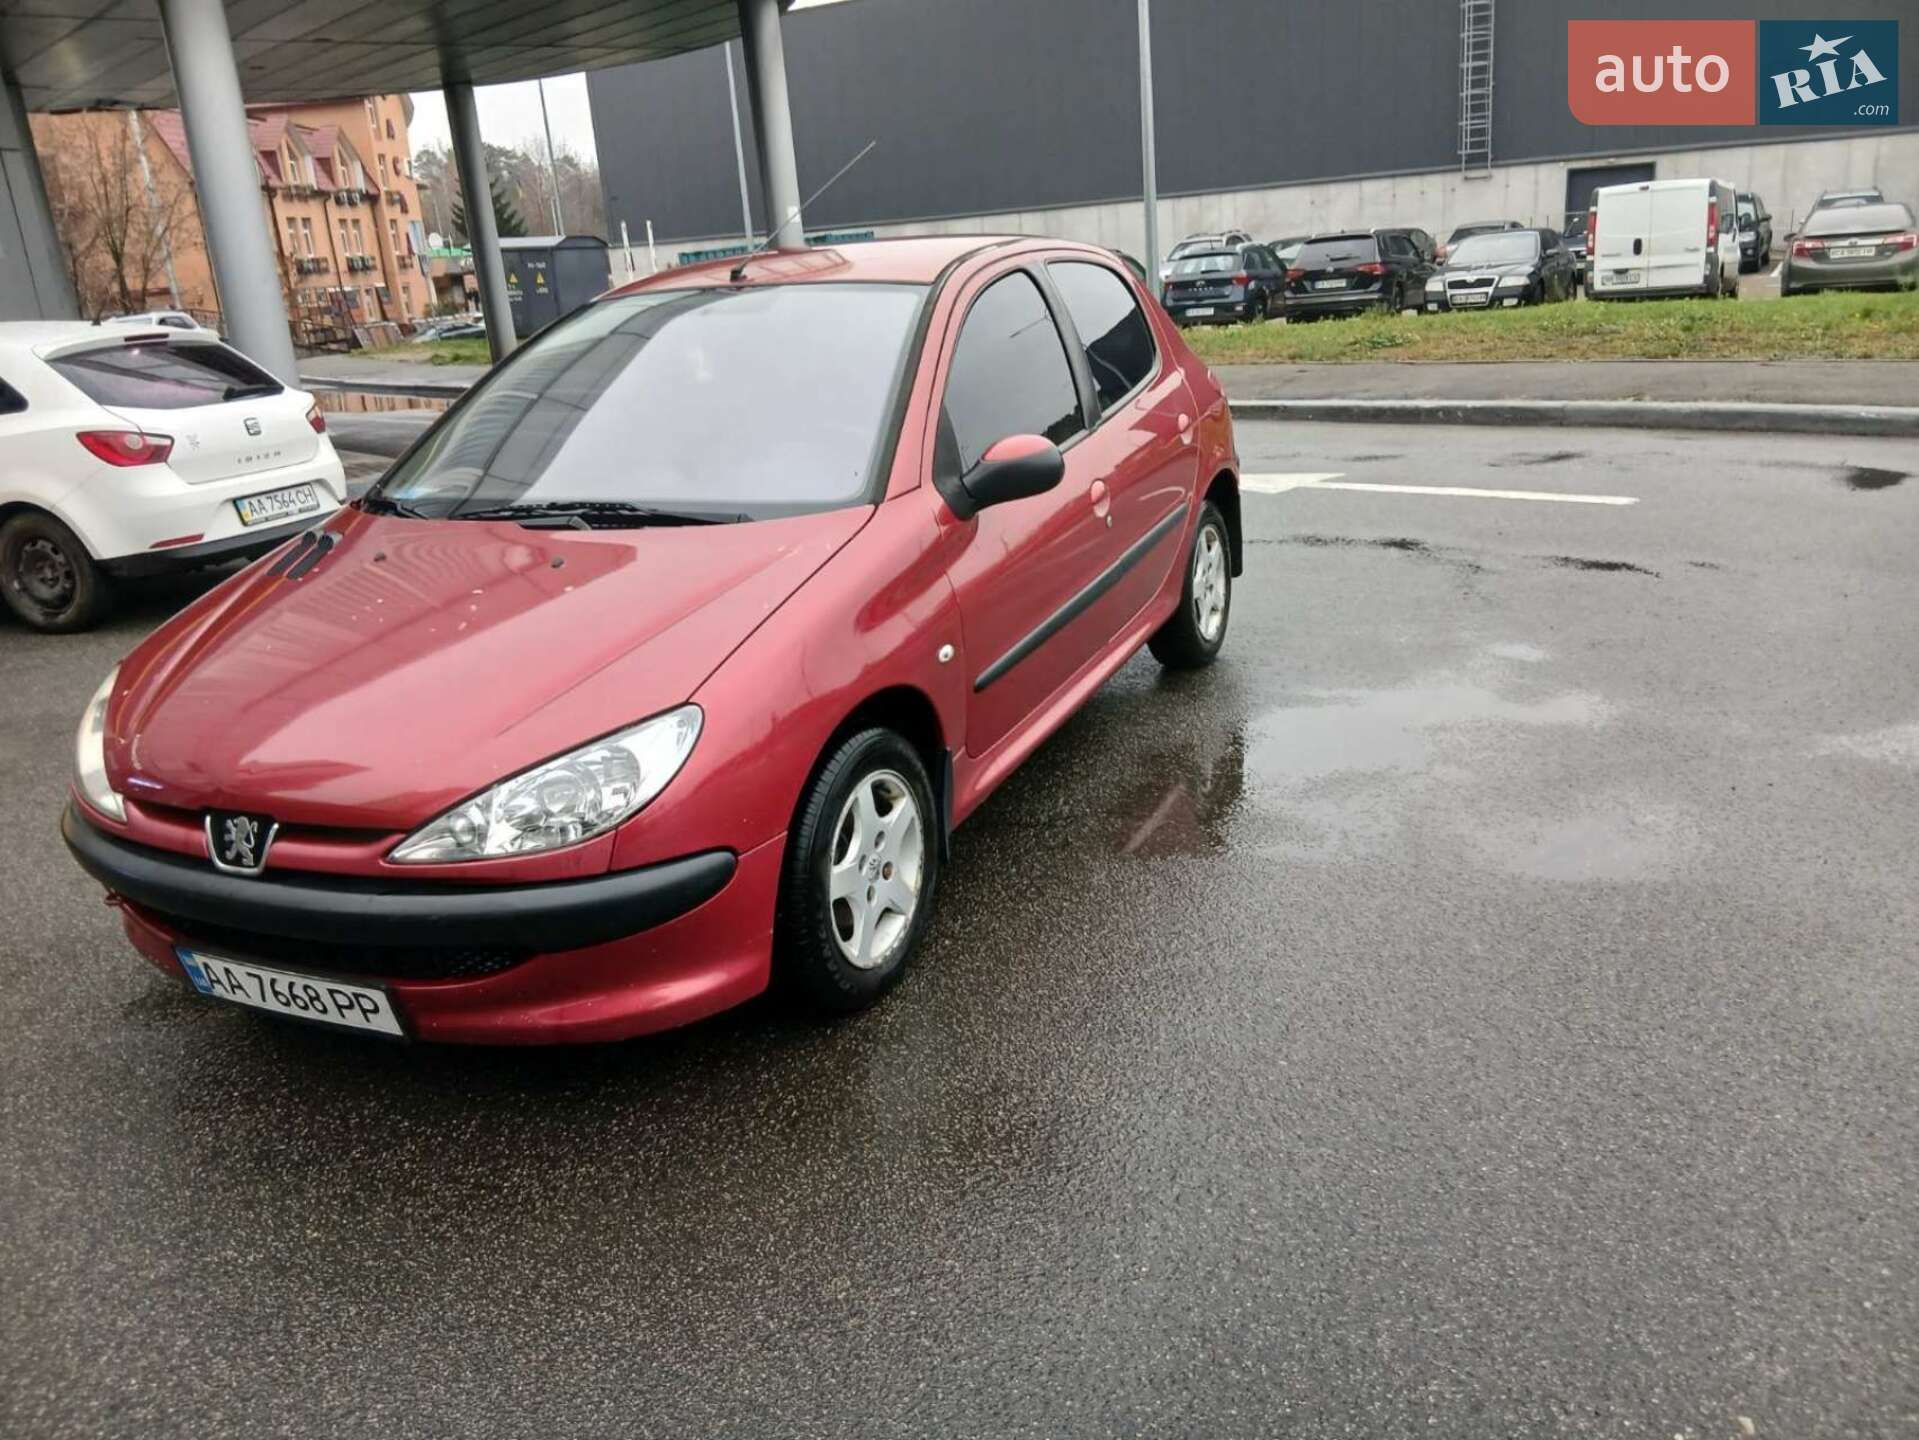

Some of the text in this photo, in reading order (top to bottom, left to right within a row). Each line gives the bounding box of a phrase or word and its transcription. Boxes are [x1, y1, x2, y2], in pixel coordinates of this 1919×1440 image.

[248, 500, 268, 517] AA
[265, 491, 296, 511] 7564
[203, 962, 380, 1023] AA 7668 PP
